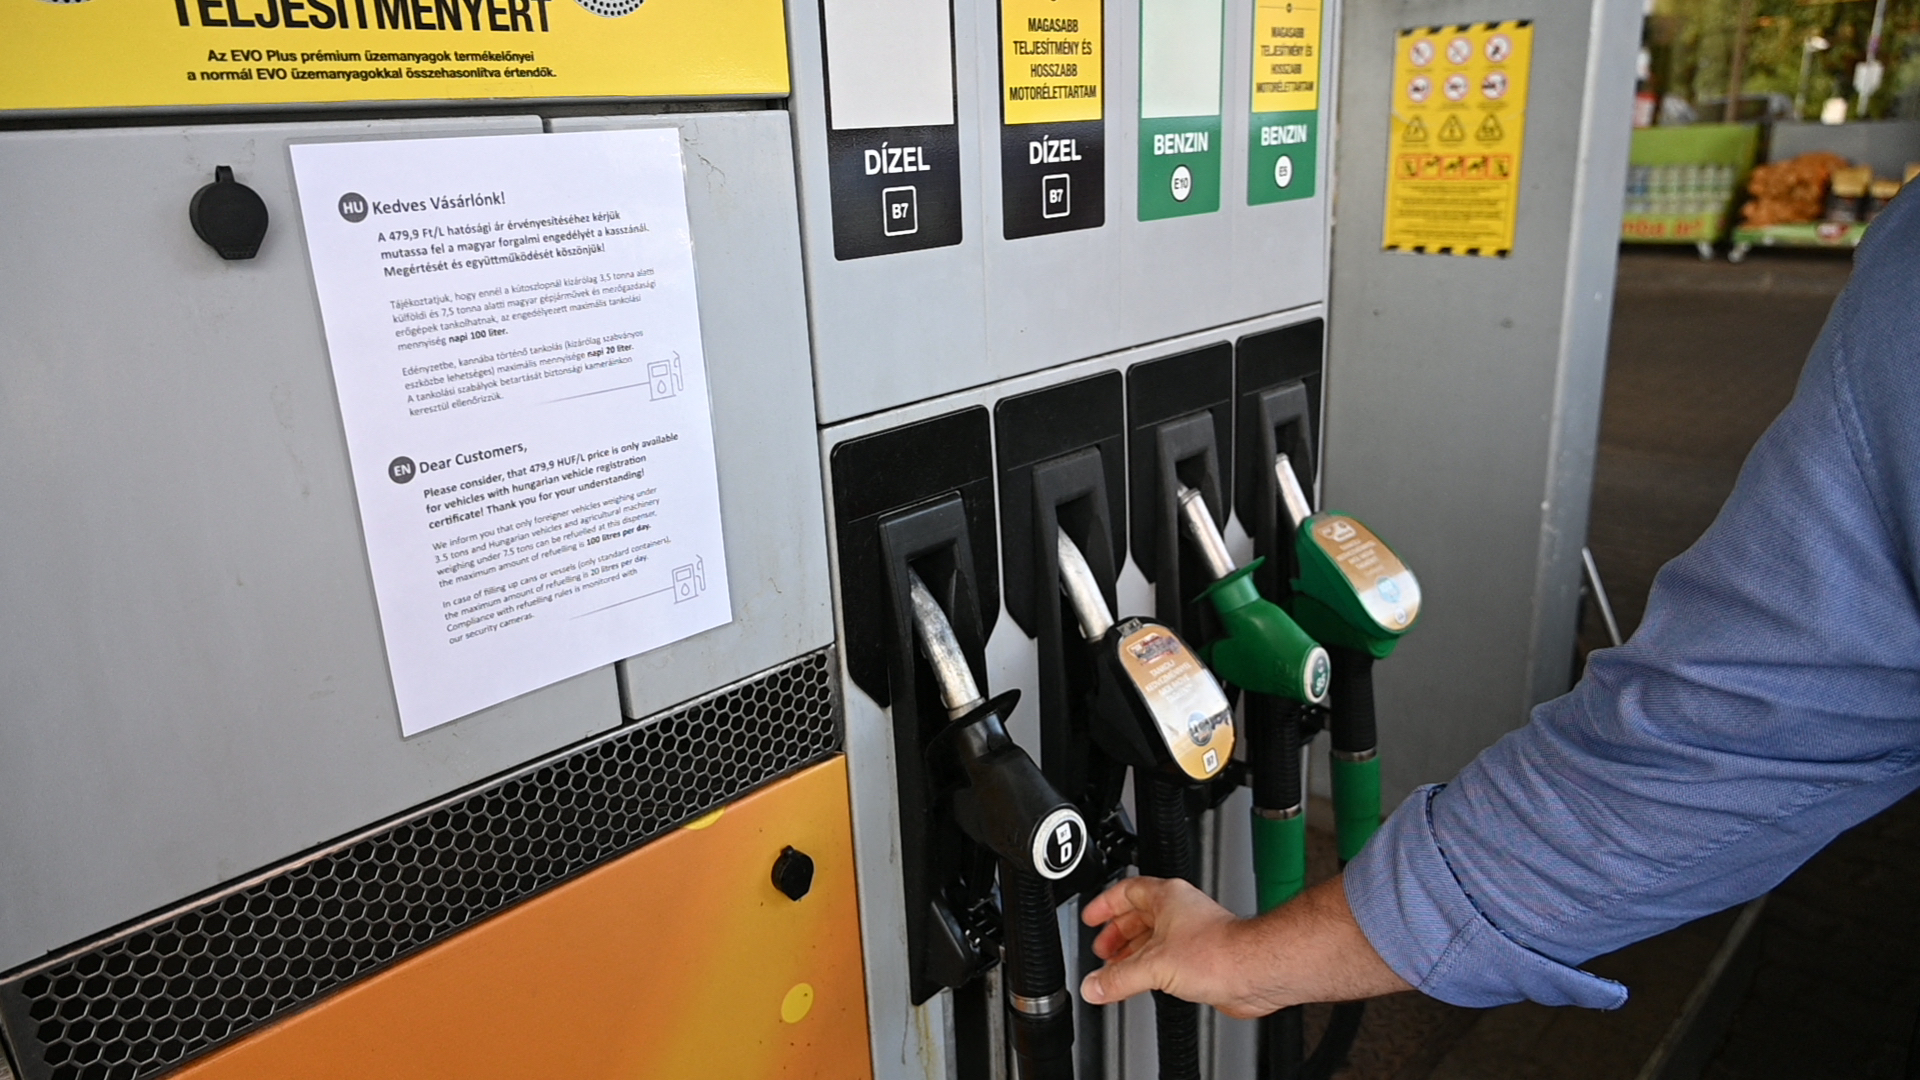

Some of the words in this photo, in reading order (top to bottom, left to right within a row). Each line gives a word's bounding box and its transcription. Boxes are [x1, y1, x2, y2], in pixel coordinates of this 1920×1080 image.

[1028, 18, 1079, 33] MAGASABB
[207, 50, 228, 62] Az
[231, 50, 262, 62] EVO
[267, 50, 297, 62] Plus
[301, 50, 362, 64] prémium
[365, 50, 451, 64] üzemanyagok
[454, 50, 534, 64] termékelőnyei
[1013, 38, 1079, 55] TELJESÍTMÉNY
[1082, 38, 1092, 55] ÉS
[187, 71, 196, 81] a
[201, 68, 253, 81] normál
[257, 69, 287, 80] EVO
[291, 67, 402, 82] üzemanyagokkal
[406, 67, 501, 79] összehasonlítva
[1030, 63, 1078, 77] HOSSZABB
[1009, 83, 1097, 101] MOTORÉLETTARTAM
[1153, 131, 1209, 156] BENZIN
[1261, 124, 1307, 146] BENZIN
[864, 142, 931, 175] DÍZEL
[1029, 135, 1082, 165] DÍZEL
[1049, 188, 1064, 204] B7
[1174, 177, 1189, 190] E10
[342, 201, 364, 215] HU
[372, 199, 427, 215] Kedves
[430, 191, 506, 210] Vásárlónk!
[891, 202, 909, 220] B7
[377, 232, 387, 243] A
[389, 229, 419, 242] 479,9
[423, 226, 445, 239] Ft/L
[447, 221, 492, 236] hatósági
[494, 220, 505, 232] ár
[507, 213, 590, 231] érvényesítéséhez
[592, 210, 621, 223] kérjük
[381, 247, 428, 260] mutassa
[430, 243, 445, 255] fel
[457, 240, 496, 252] magyar
[498, 233, 542, 248] forgalmi
[543, 229, 595, 244] engedélyét
[384, 261, 448, 277] Megértését
[452, 258, 463, 270] és
[465, 248, 554, 269] együttműködését
[556, 243, 605, 258] köszönjük!
[454, 292, 476, 302] hogy
[478, 287, 502, 298] ennél
[393, 312, 427, 323] külföldi
[429, 310, 439, 319] és
[441, 307, 455, 317] 7,5
[456, 304, 481, 315] tonna
[507, 297, 537, 308] magyar
[501, 314, 510, 322] az
[397, 337, 447, 351] mennyiség
[448, 332, 468, 344] napi
[471, 329, 487, 340] 100
[488, 327, 509, 337] liter.
[587, 347, 604, 359] napi
[605, 345, 616, 354] 20
[407, 394, 415, 403] A
[416, 388, 456, 402] tankolási
[409, 401, 449, 416] keresztül
[393, 462, 412, 477] EN
[419, 458, 452, 474] Dear
[455, 442, 528, 466] Customers,
[423, 484, 458, 499] Please
[460, 473, 505, 490] consider,
[506, 468, 527, 480] that
[529, 459, 555, 473] 479,9
[557, 453, 585, 467] HUF/L
[587, 448, 610, 462] price
[621, 442, 640, 454] only
[641, 432, 679, 448] available
[425, 503, 441, 514] for
[444, 492, 486, 510] vehicles
[487, 486, 510, 499] with
[512, 474, 560, 493] hungarian
[561, 466, 594, 481] vehicle
[596, 454, 647, 473] registration
[428, 507, 484, 529] certificate!
[487, 499, 517, 515] Thank
[518, 496, 537, 509] you
[538, 490, 555, 502] for
[555, 485, 577, 499] your
[578, 468, 645, 492] understanding!
[432, 541, 448, 551] We
[449, 533, 478, 547] inform
[480, 530, 496, 541] you
[496, 523, 514, 534] that
[515, 519, 533, 530] only
[534, 509, 569, 524] foreigner
[571, 502, 601, 515] vehicles
[603, 493, 635, 506] weighing
[636, 487, 657, 497] under
[450, 548, 469, 559] tons
[471, 543, 487, 554] and
[488, 532, 530, 549] Hungarian
[531, 523, 563, 537] vehicles
[564, 517, 578, 528] and
[580, 507, 621, 525] agricultural
[623, 498, 660, 512] machinery
[437, 559, 475, 576] weighing
[476, 551, 501, 564] under
[503, 548, 515, 558] 7.5
[517, 543, 534, 553] tons
[535, 538, 550, 549] can
[551, 533, 561, 544] be
[562, 524, 596, 540] refuelled
[607, 518, 621, 529] this
[438, 578, 454, 588] the
[455, 566, 497, 583] maximum
[498, 556, 530, 571] amount
[541, 541, 577, 558] refuelling
[586, 536, 601, 546] 100
[602, 530, 621, 542] litres
[622, 527, 635, 538] per
[636, 522, 651, 533] day.
[442, 600, 451, 609] In
[452, 594, 472, 606] case
[473, 590, 482, 599] of
[508, 580, 518, 591] up
[520, 575, 538, 586] cans
[597, 547, 630, 563] standard
[444, 610, 459, 621] the
[460, 598, 502, 615] maximum
[503, 588, 534, 603] amount
[536, 584, 544, 593] of
[590, 567, 600, 577] 20
[601, 562, 620, 573] litres
[620, 558, 633, 569] per
[446, 613, 495, 632] Compliance
[496, 605, 515, 617] with
[554, 588, 573, 600] rules
[622, 568, 638, 579] with
[449, 634, 463, 645] our
[465, 624, 498, 640] security
[499, 613, 535, 629] cameras.
[1060, 841, 1073, 864] D
